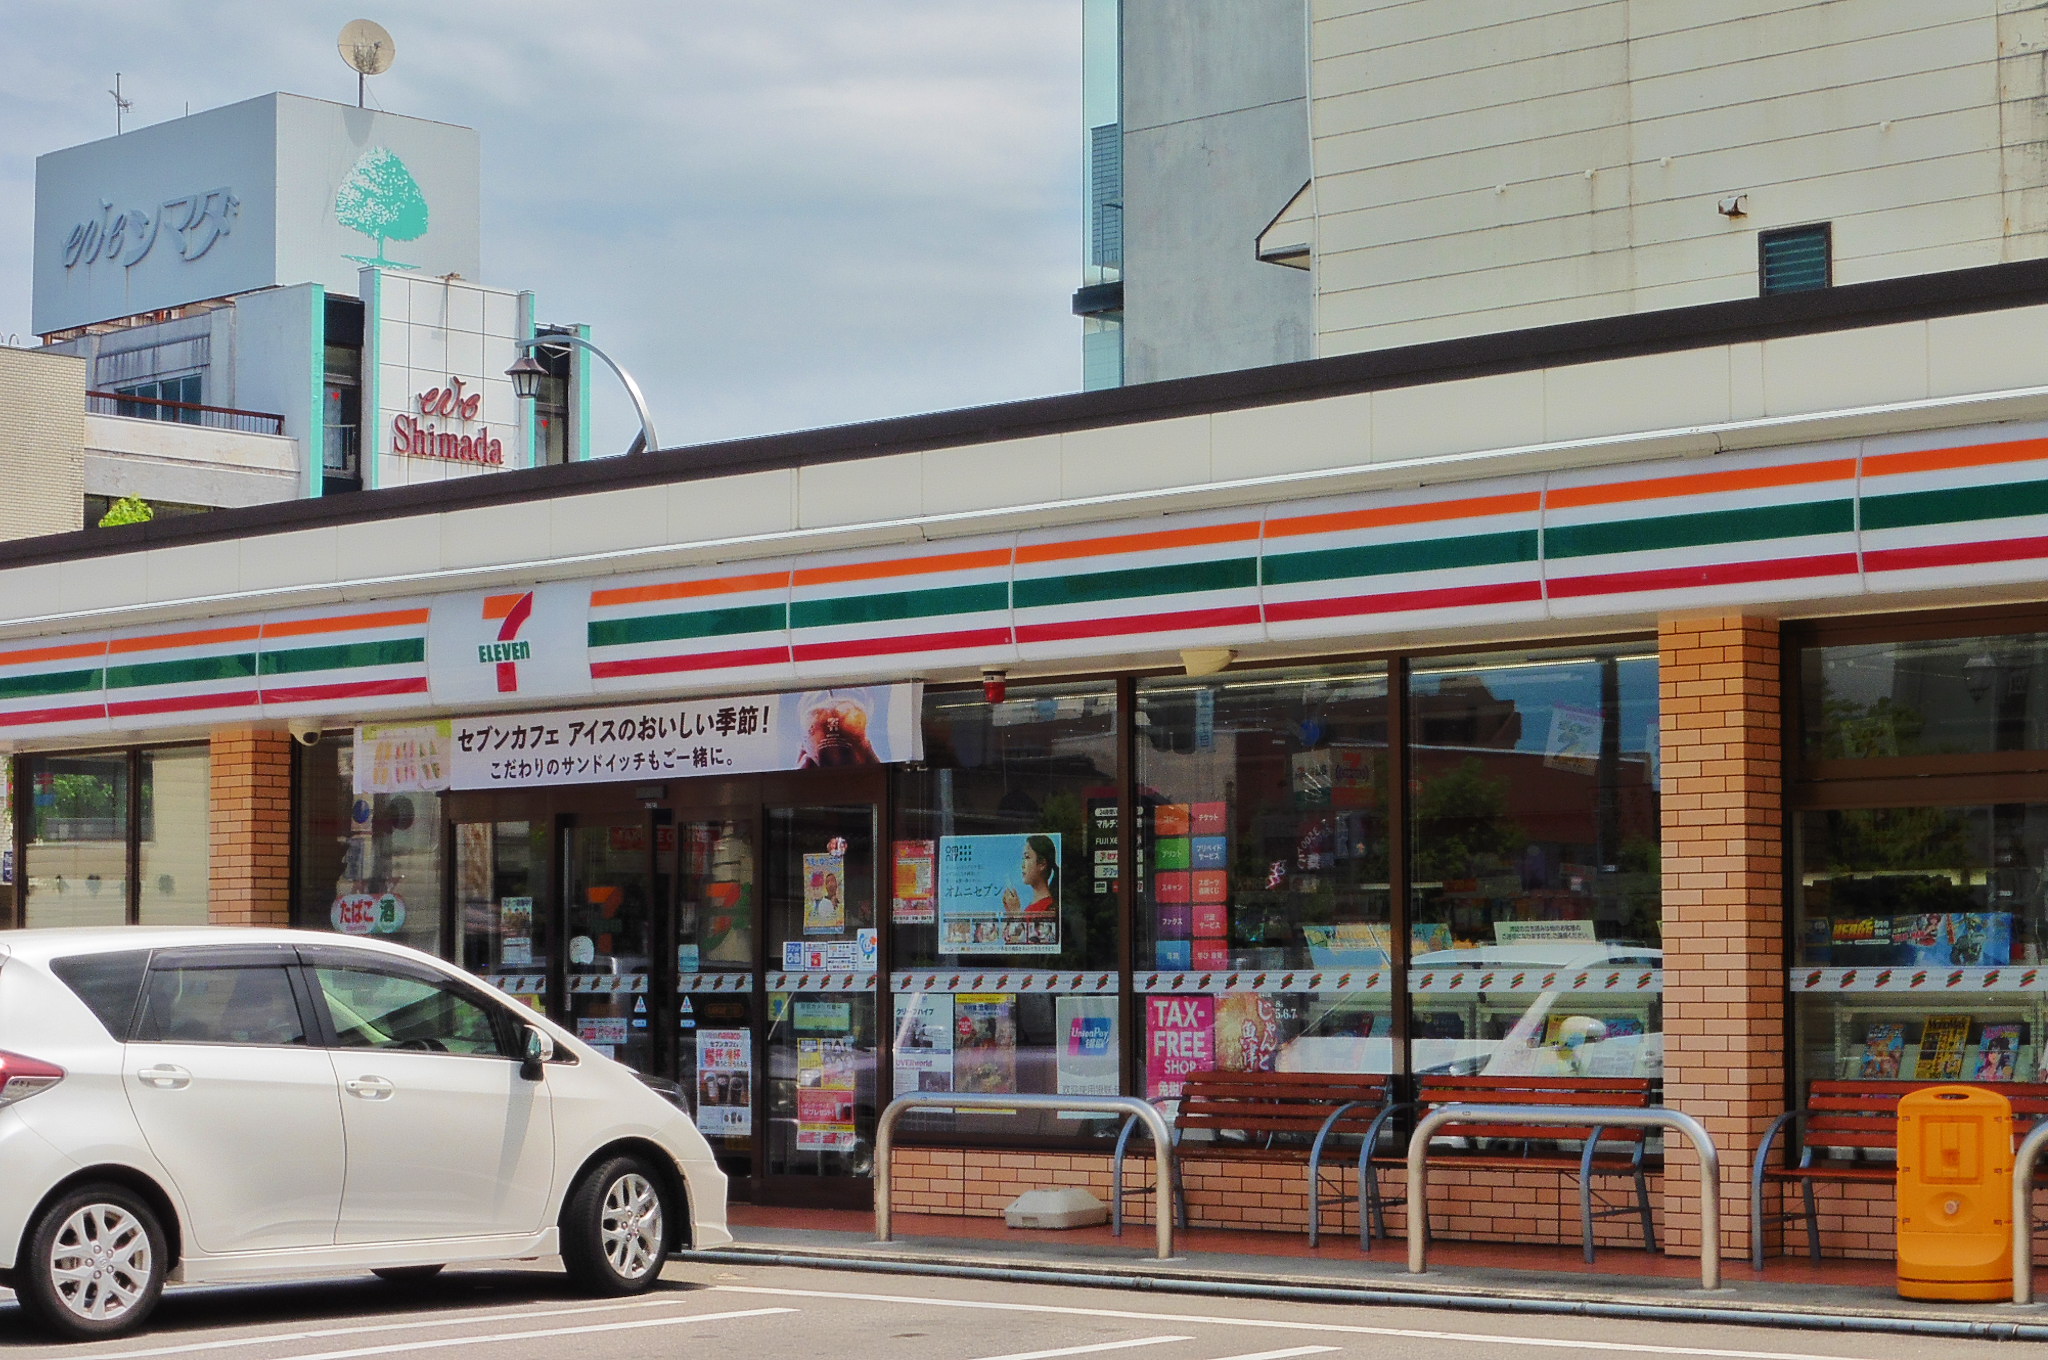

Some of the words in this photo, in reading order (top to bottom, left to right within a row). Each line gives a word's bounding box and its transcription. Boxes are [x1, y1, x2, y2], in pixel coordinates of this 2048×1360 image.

[392, 413, 504, 465] Shimada
[482, 590, 535, 692] 7
[457, 724, 560, 752] セブンカフェ
[568, 705, 770, 747] アイスのおいしい季節!
[490, 745, 733, 780] こだわりのサンドイッチもご一緒に。
[1198, 813, 1219, 822] チケット
[1095, 837, 1109, 845] FUJI
[944, 882, 1004, 898] オムニセブン
[1161, 883, 1183, 892] スキャン
[339, 898, 375, 924] たばこ
[379, 898, 396, 923] 酒
[1199, 921, 1221, 930] サービス
[1153, 1000, 1206, 1028] TAX-
[1071, 1026, 1109, 1043] UnionPay
[1153, 1031, 1207, 1058] FREE
[1164, 1060, 1197, 1075] SHOP
[1158, 1081, 1184, 1096] 免税
